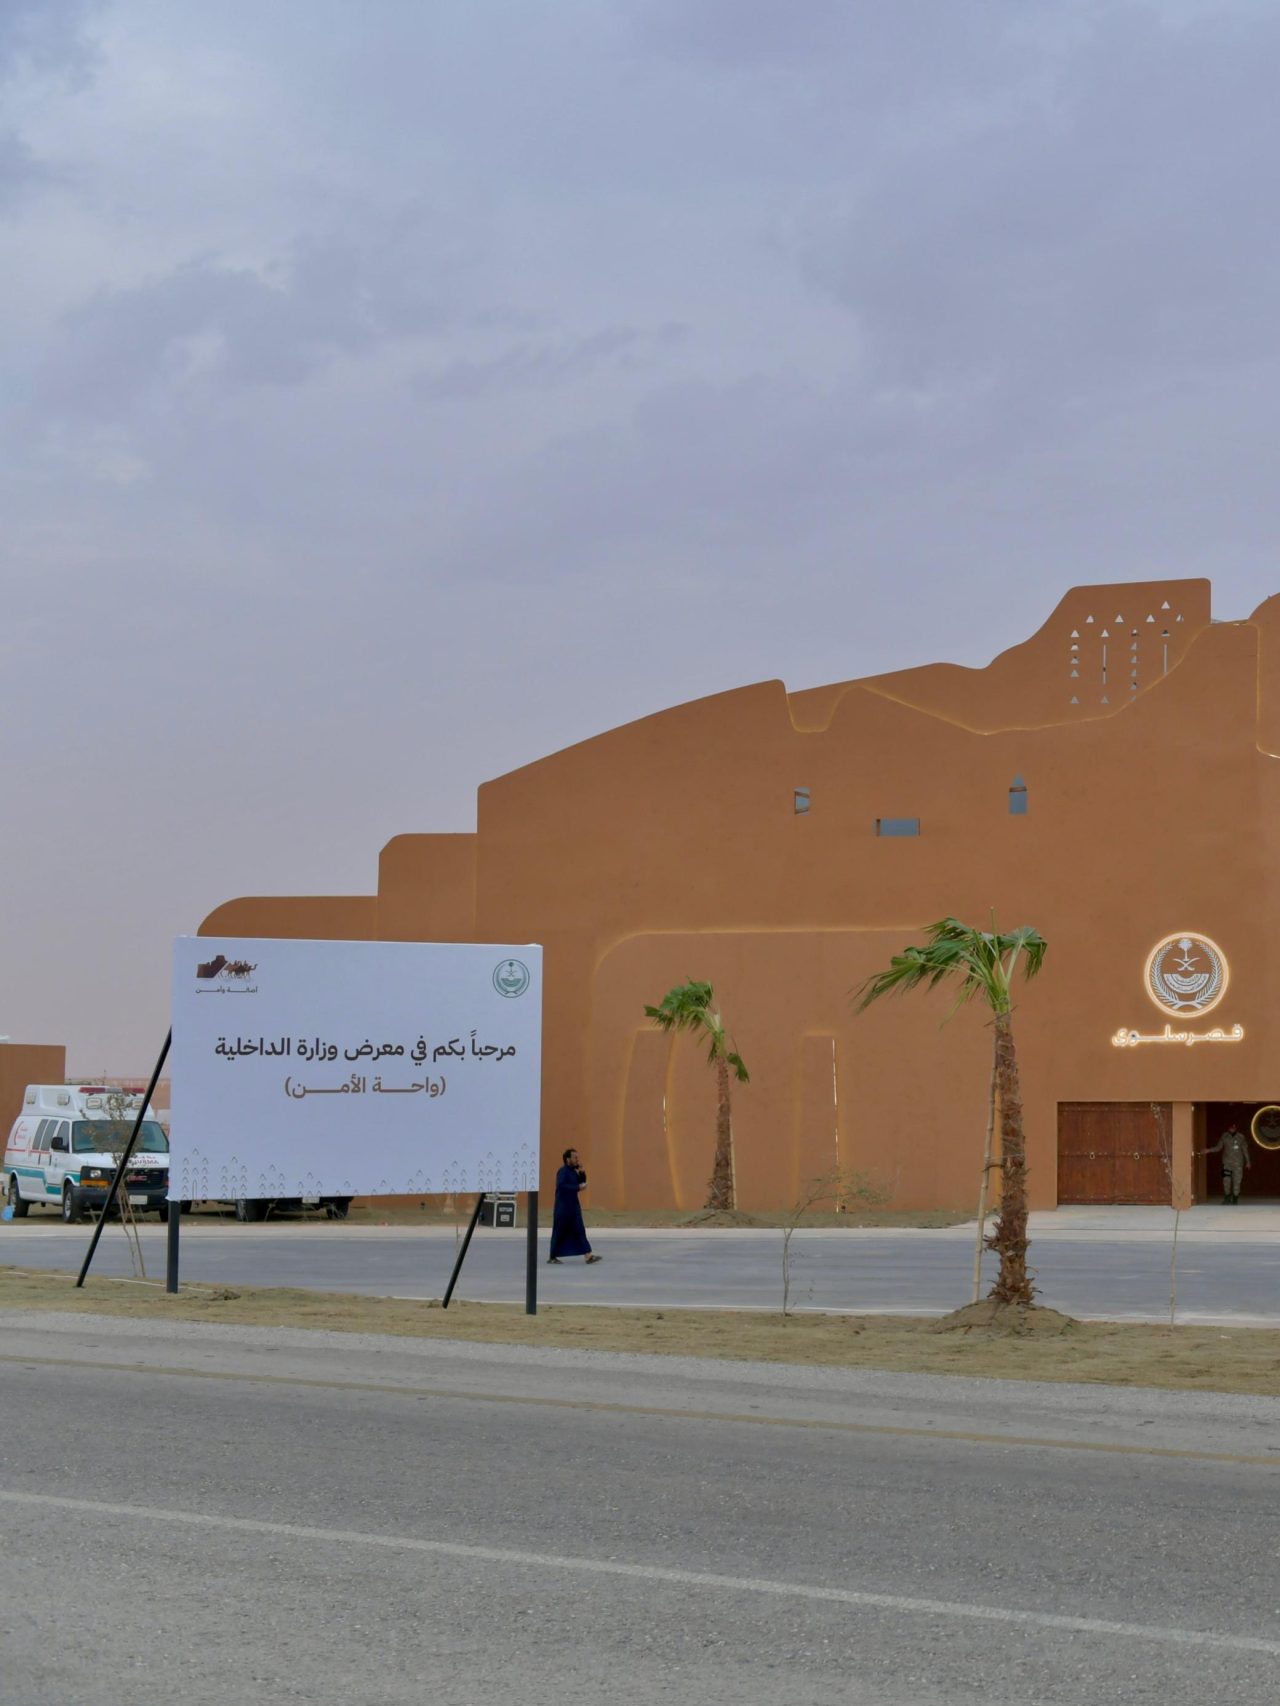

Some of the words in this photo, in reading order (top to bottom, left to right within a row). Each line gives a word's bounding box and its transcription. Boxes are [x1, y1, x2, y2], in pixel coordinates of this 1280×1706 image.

[470, 1029, 517, 1060] مرحباً
[1186, 1023, 1244, 1047] قصر
[214, 1037, 291, 1061] الداخلية
[296, 1038, 339, 1062] وزارة
[343, 1040, 405, 1062] معرض
[410, 1035, 428, 1066] في
[432, 1038, 466, 1063] بكم
